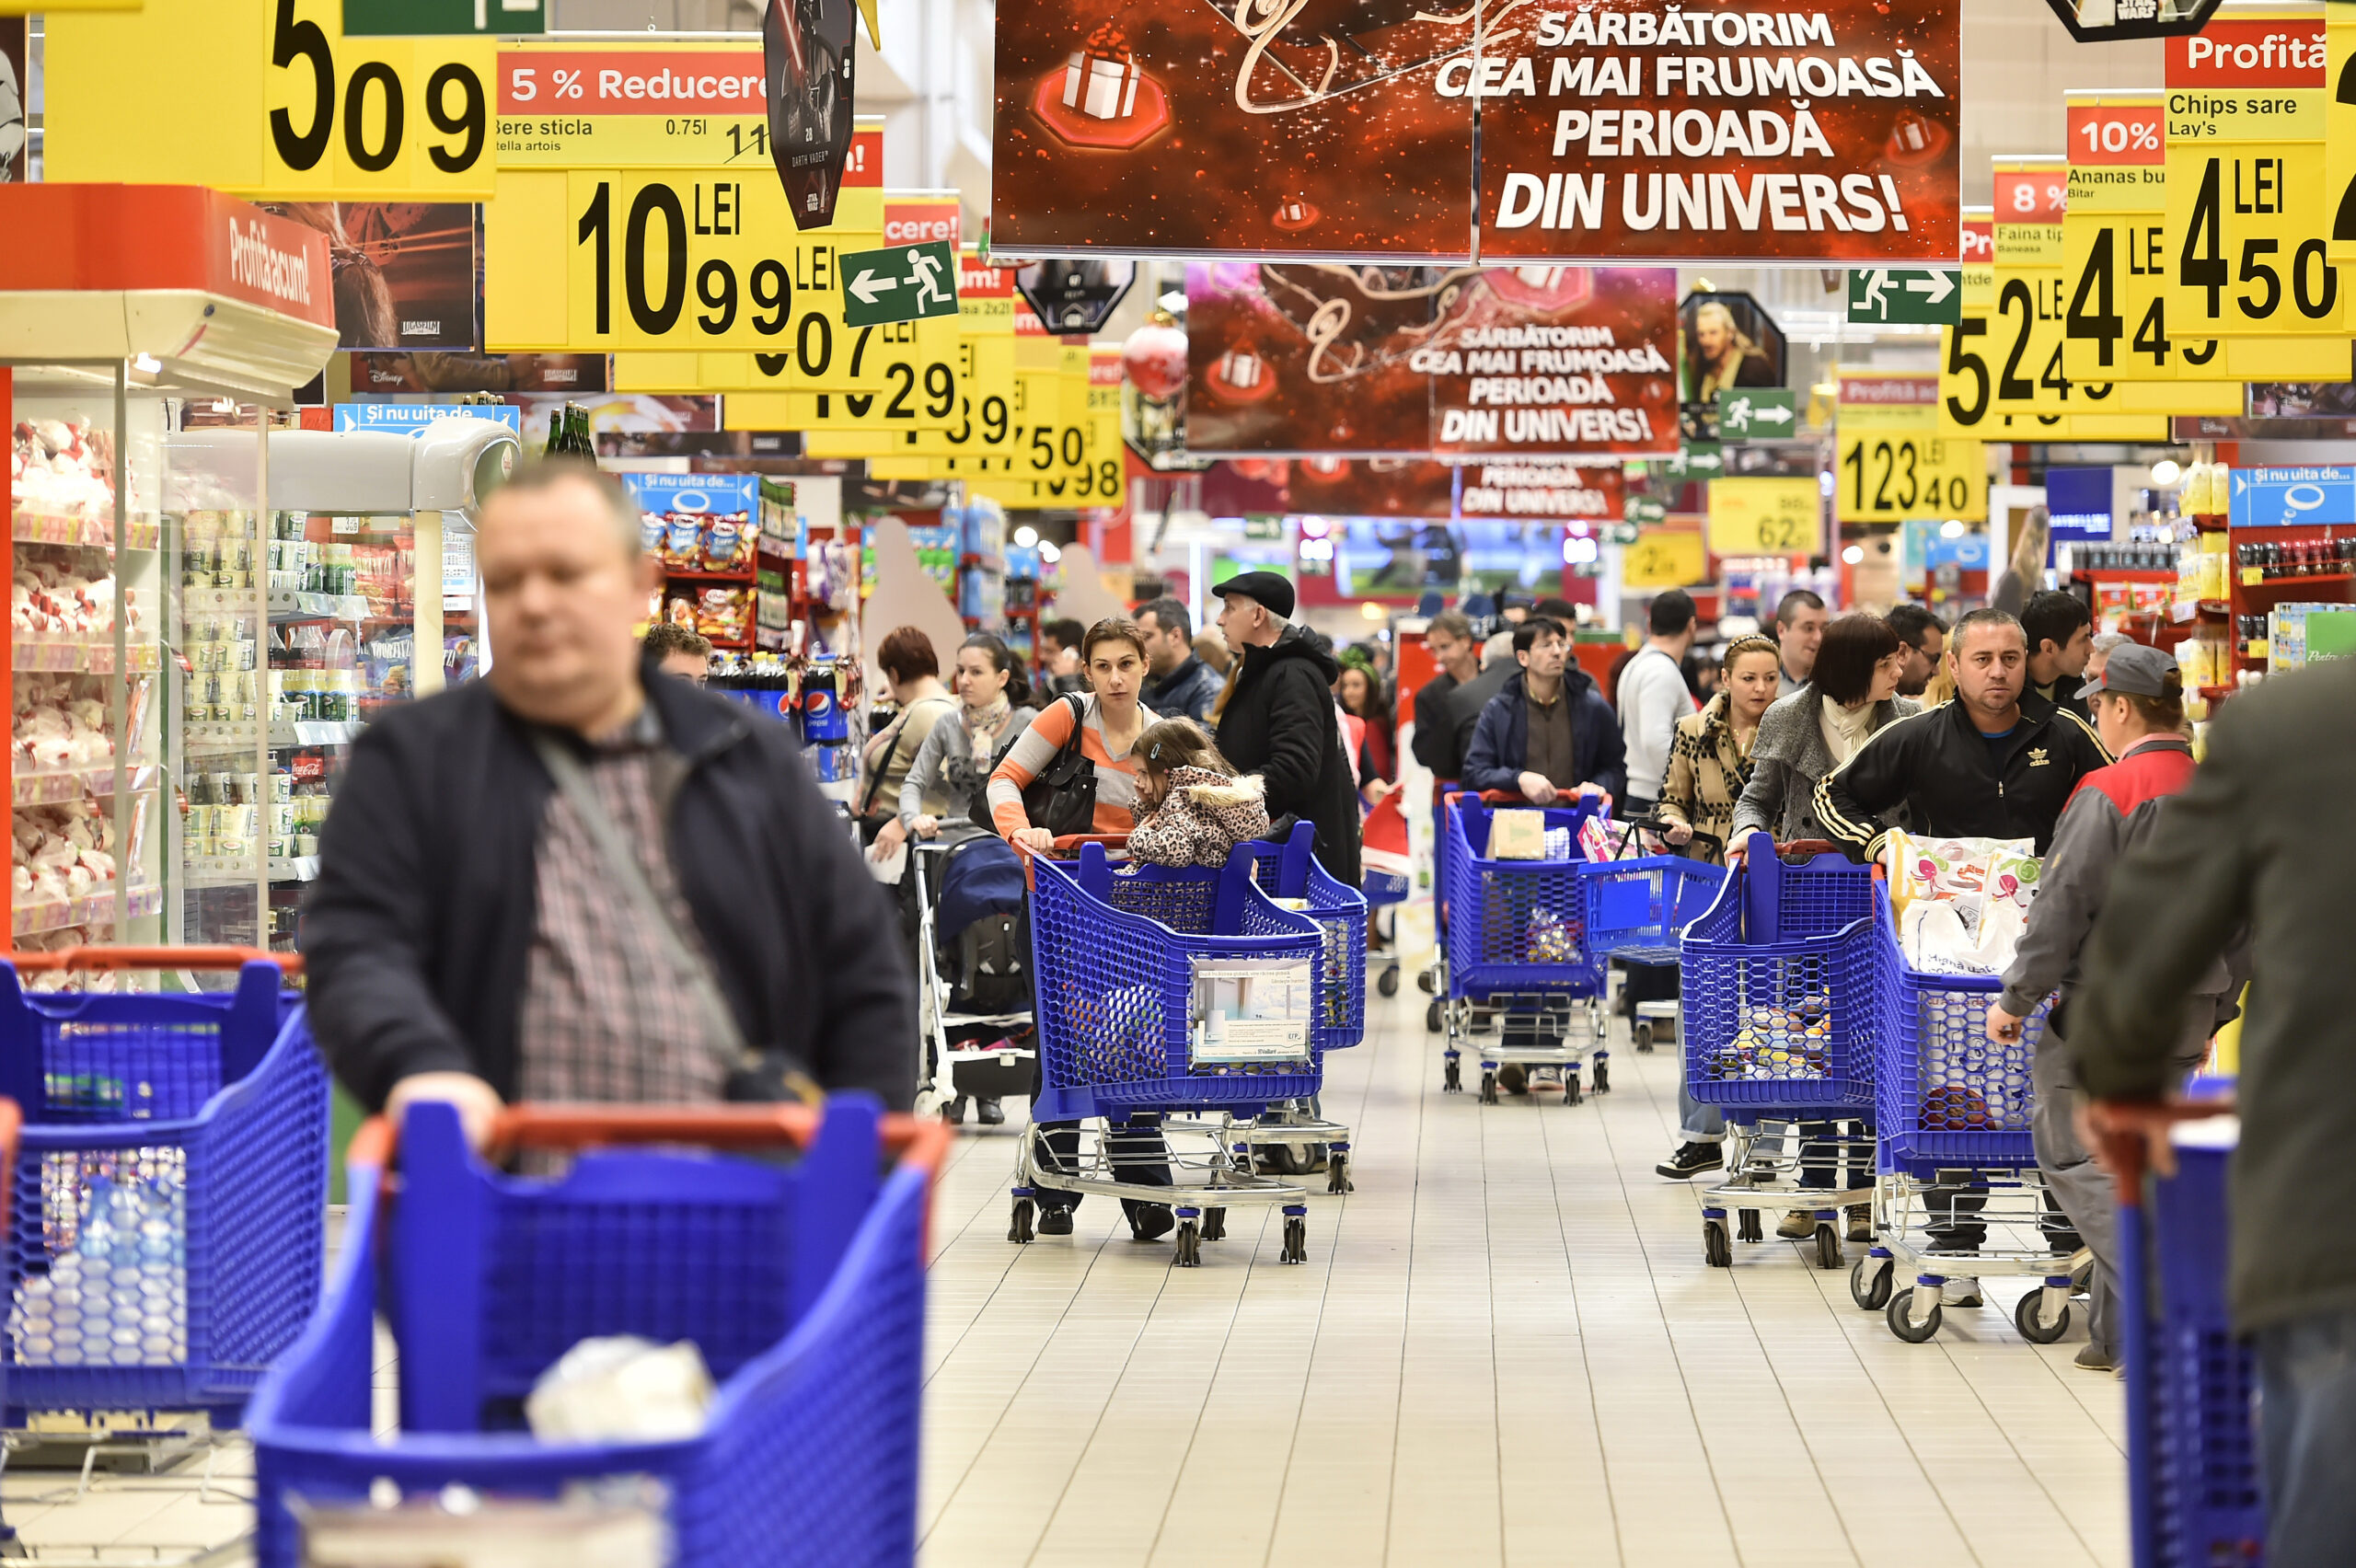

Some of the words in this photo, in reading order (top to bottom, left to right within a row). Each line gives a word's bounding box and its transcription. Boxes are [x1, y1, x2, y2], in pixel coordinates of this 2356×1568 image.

[1537, 5, 1836, 47] SĂRBĂTORIM
[2117, 6, 2156, 20] WARS
[512, 68, 537, 101] 5
[1435, 57, 1536, 97] CEA
[1548, 56, 1641, 96] MAI
[1657, 49, 1945, 98] FRUMOASĂ
[2169, 95, 2238, 118] Chips
[2246, 98, 2297, 115] sare
[539, 119, 594, 135] sticla
[666, 120, 707, 135] 0.75l
[1552, 99, 1834, 156] PERIOADĂ
[2081, 121, 2159, 153] 10%
[2169, 121, 2217, 138] Lay's
[496, 140, 522, 151] tella
[525, 141, 561, 151] artois
[792, 155, 808, 167] DARTH
[2068, 169, 2136, 183] Ananas
[2143, 169, 2165, 183] bu
[2014, 183, 2036, 212] 8
[2068, 189, 2095, 198] Bitar
[2235, 158, 2282, 213] LEI
[694, 183, 740, 235] LEI
[1495, 173, 1605, 229] DIN
[1622, 174, 1909, 232] UNIVERS!
[885, 216, 958, 239] cere!
[1998, 226, 2040, 240] Faina
[796, 247, 835, 290] LEI
[2237, 238, 2338, 318] 50
[697, 259, 791, 335] 99
[1459, 324, 1615, 349] SĂRBĂTORIM
[1409, 349, 1462, 375] CEA
[1467, 350, 1517, 374] MAI
[1520, 344, 1671, 374] FRUMOASĂ
[370, 369, 403, 386] Disney
[885, 362, 954, 418] 29
[1468, 373, 1615, 405] PERIOADĂ
[387, 408, 409, 421] nu
[412, 405, 446, 421] uita
[1440, 409, 1499, 443] DIN
[1504, 408, 1654, 443] UNIVERS!
[1031, 427, 1083, 470] 50
[659, 477, 677, 487] nu
[678, 475, 705, 487] uita
[2271, 470, 2290, 481] nu
[2291, 467, 2319, 481] uita
